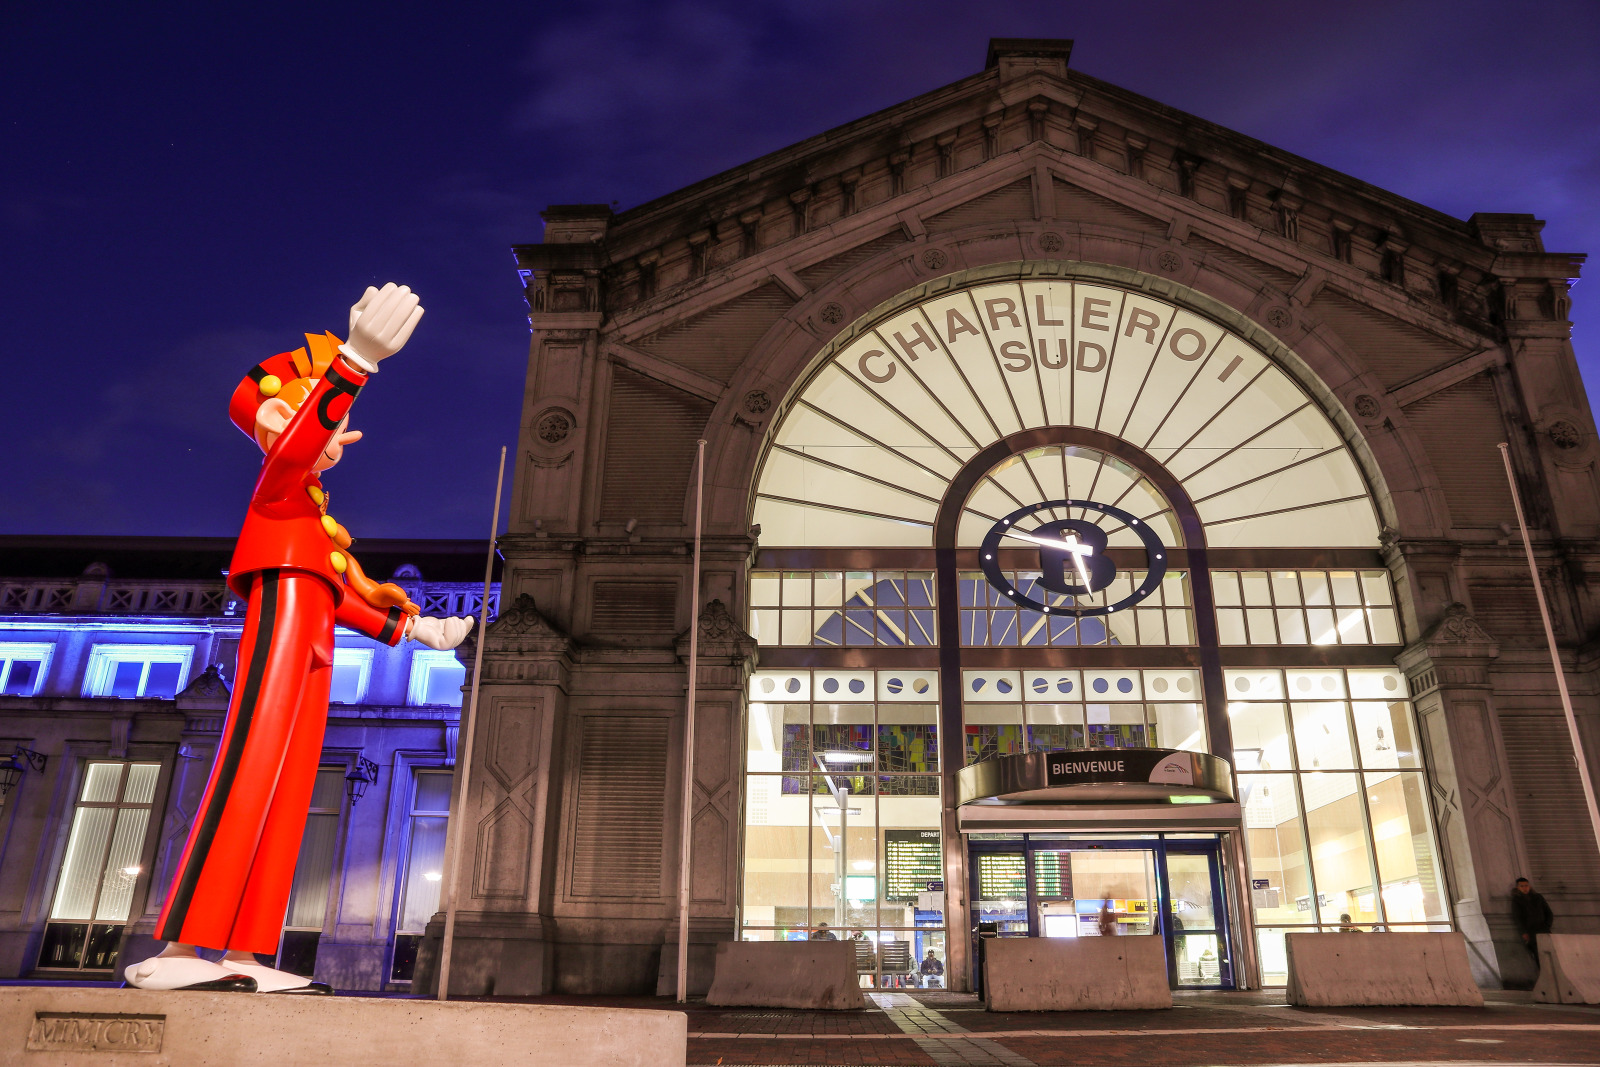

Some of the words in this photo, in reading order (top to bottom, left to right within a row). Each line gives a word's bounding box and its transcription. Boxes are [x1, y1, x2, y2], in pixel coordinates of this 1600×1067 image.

[858, 295, 1244, 383] CHARLEROI
[999, 338, 1107, 373] SUD
[1052, 760, 1125, 775] BIENVENUE
[35, 1020, 164, 1043] MIMICRY
